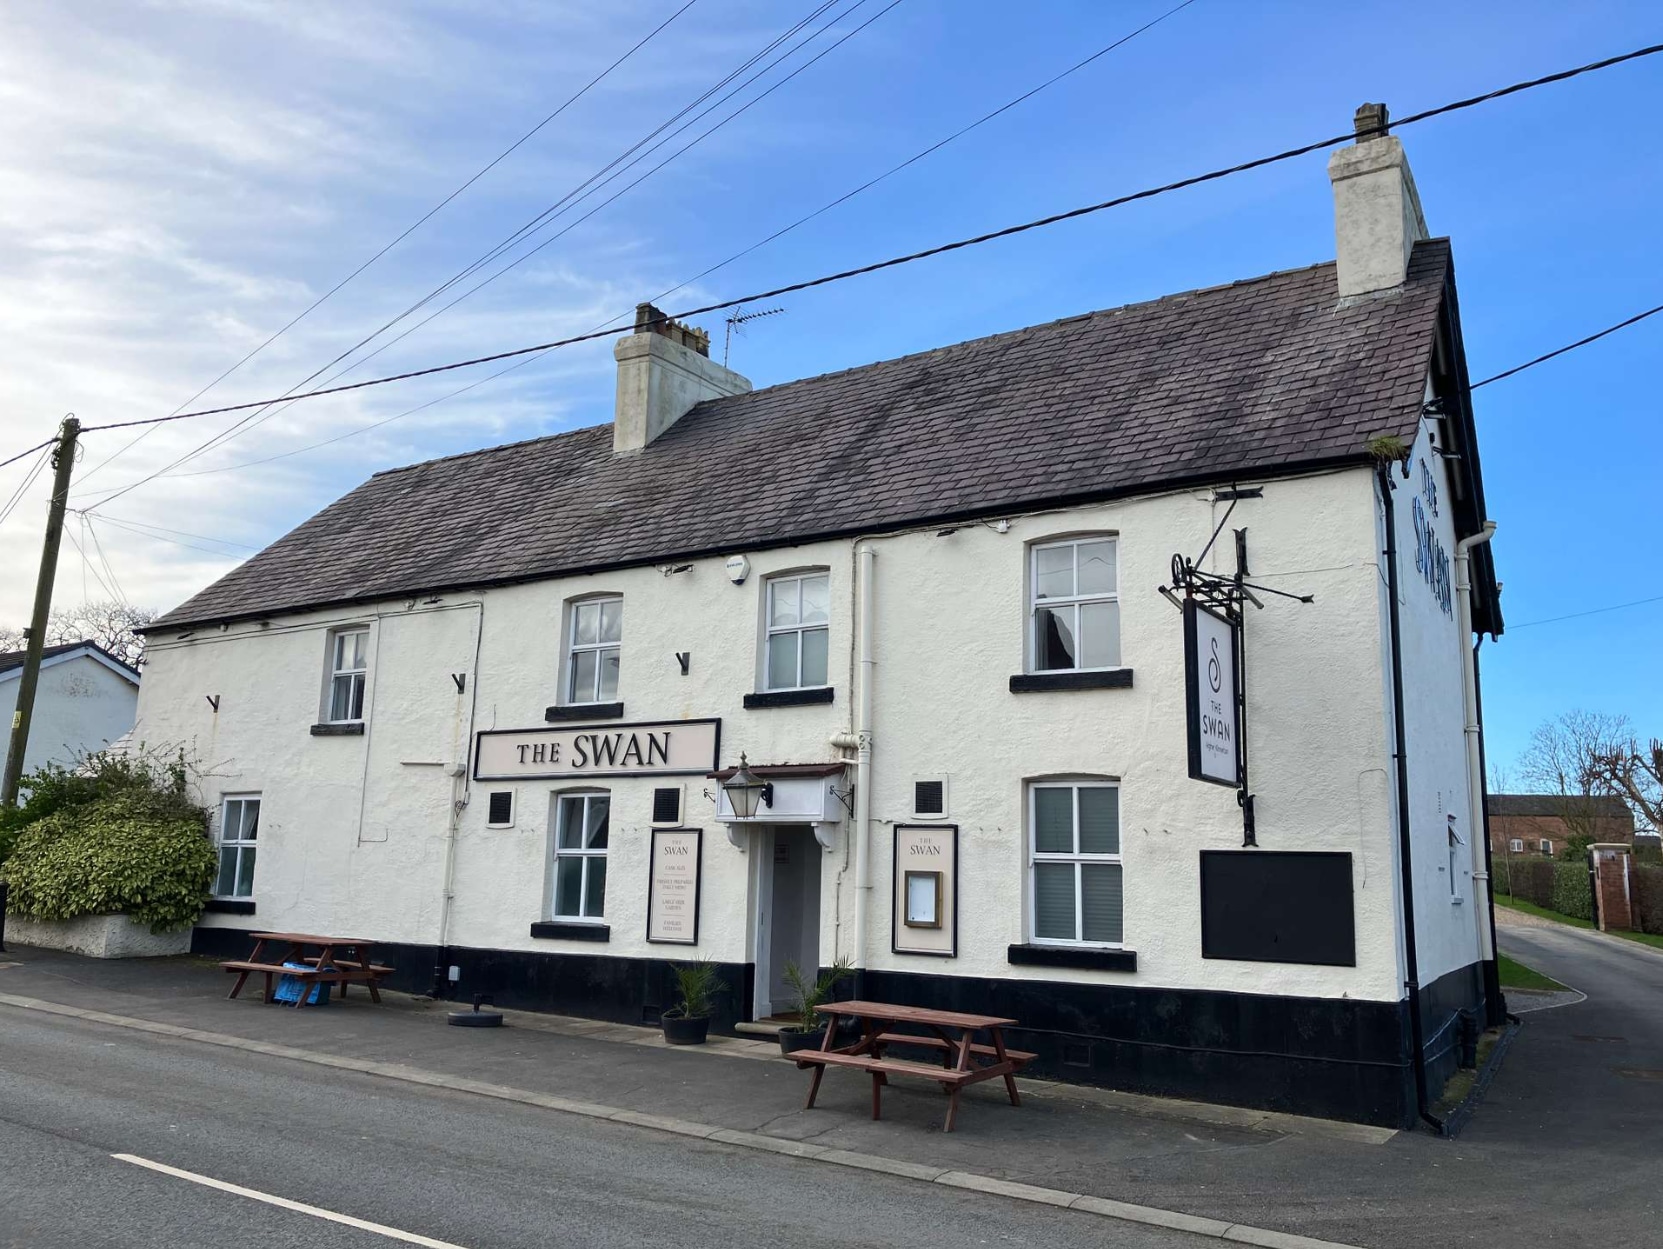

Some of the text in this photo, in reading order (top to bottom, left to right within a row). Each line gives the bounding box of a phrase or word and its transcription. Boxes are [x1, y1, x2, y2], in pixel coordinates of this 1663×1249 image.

[1419, 457, 1439, 518] THE
[1412, 495, 1454, 622] SWAN
[1210, 700, 1222, 715] THE
[1202, 714, 1231, 742] SWAN
[516, 731, 672, 768] THE SWAN
[664, 846, 689, 856] SWAN
[910, 844, 941, 856] SWAN
